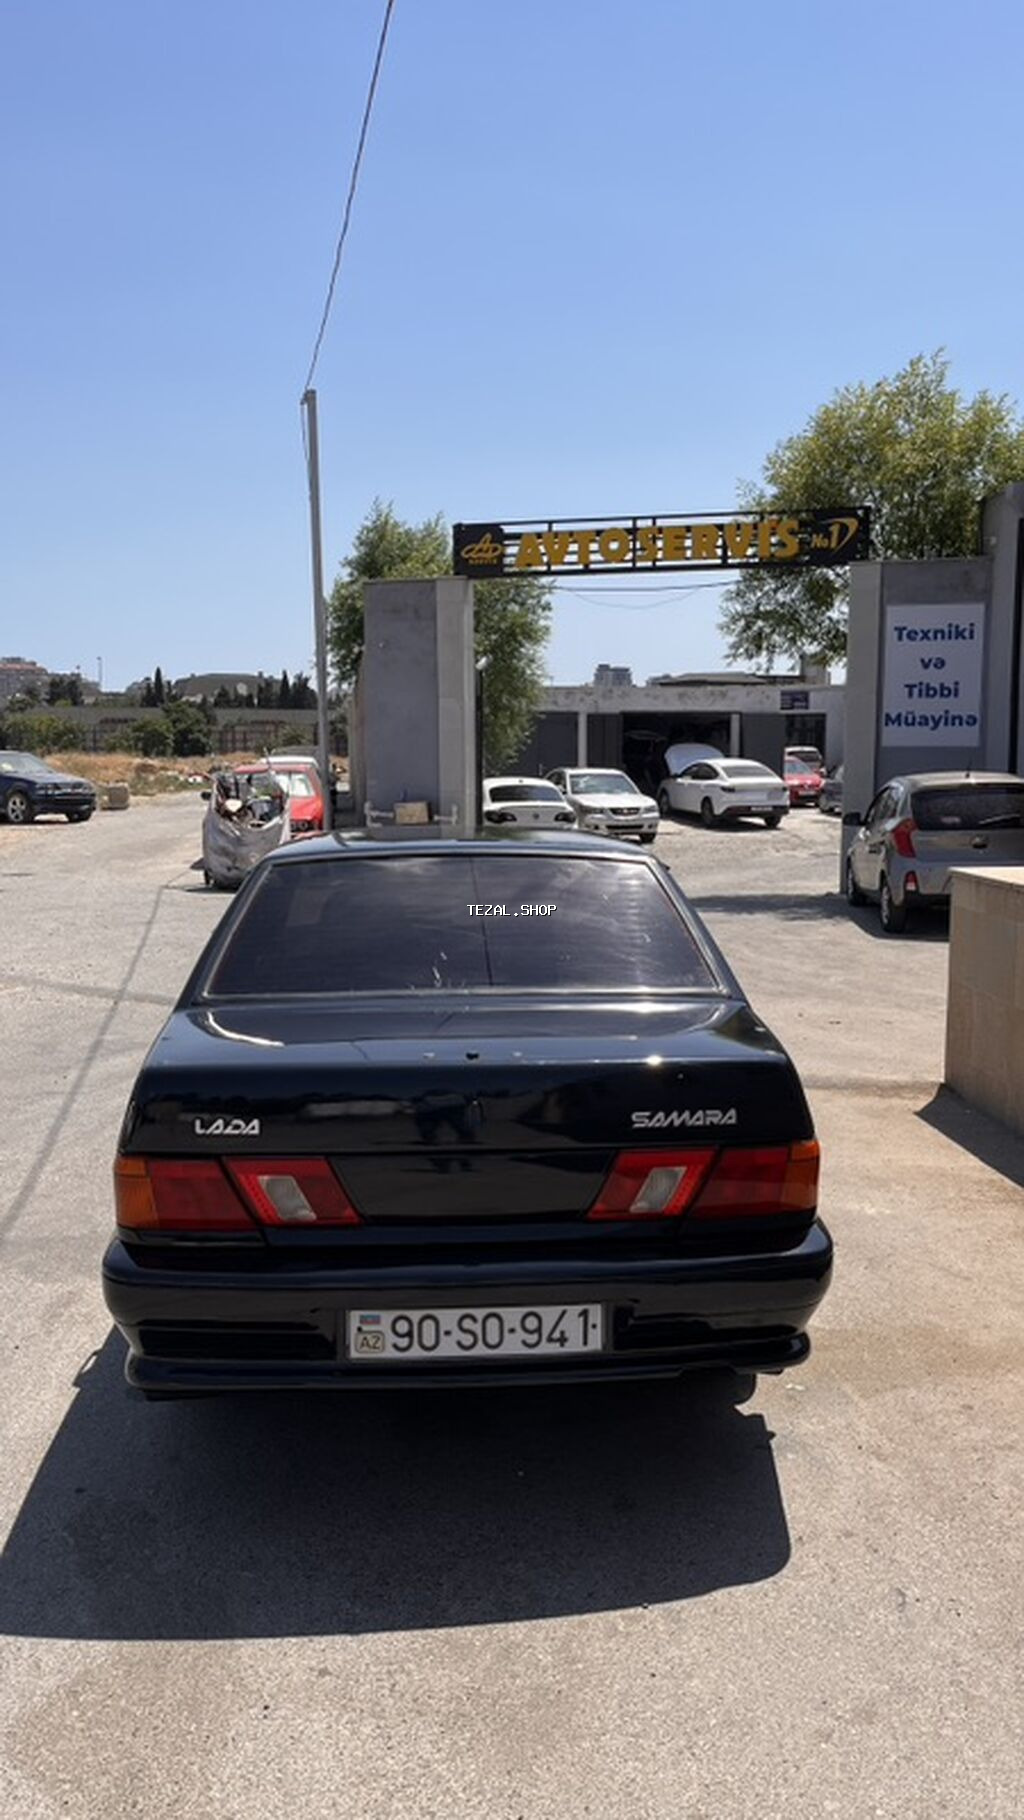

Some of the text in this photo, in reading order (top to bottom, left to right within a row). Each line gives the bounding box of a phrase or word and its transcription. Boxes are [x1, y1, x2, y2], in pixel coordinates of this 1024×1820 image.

[893, 623, 975, 642] Texniki
[920, 656, 946, 670] və
[904, 681, 960, 700] Tibbi
[884, 710, 978, 731] Müayinə
[194, 1118, 261, 1135] LADA
[630, 1107, 738, 1128] SAMARA
[359, 1334, 382, 1350] AZ
